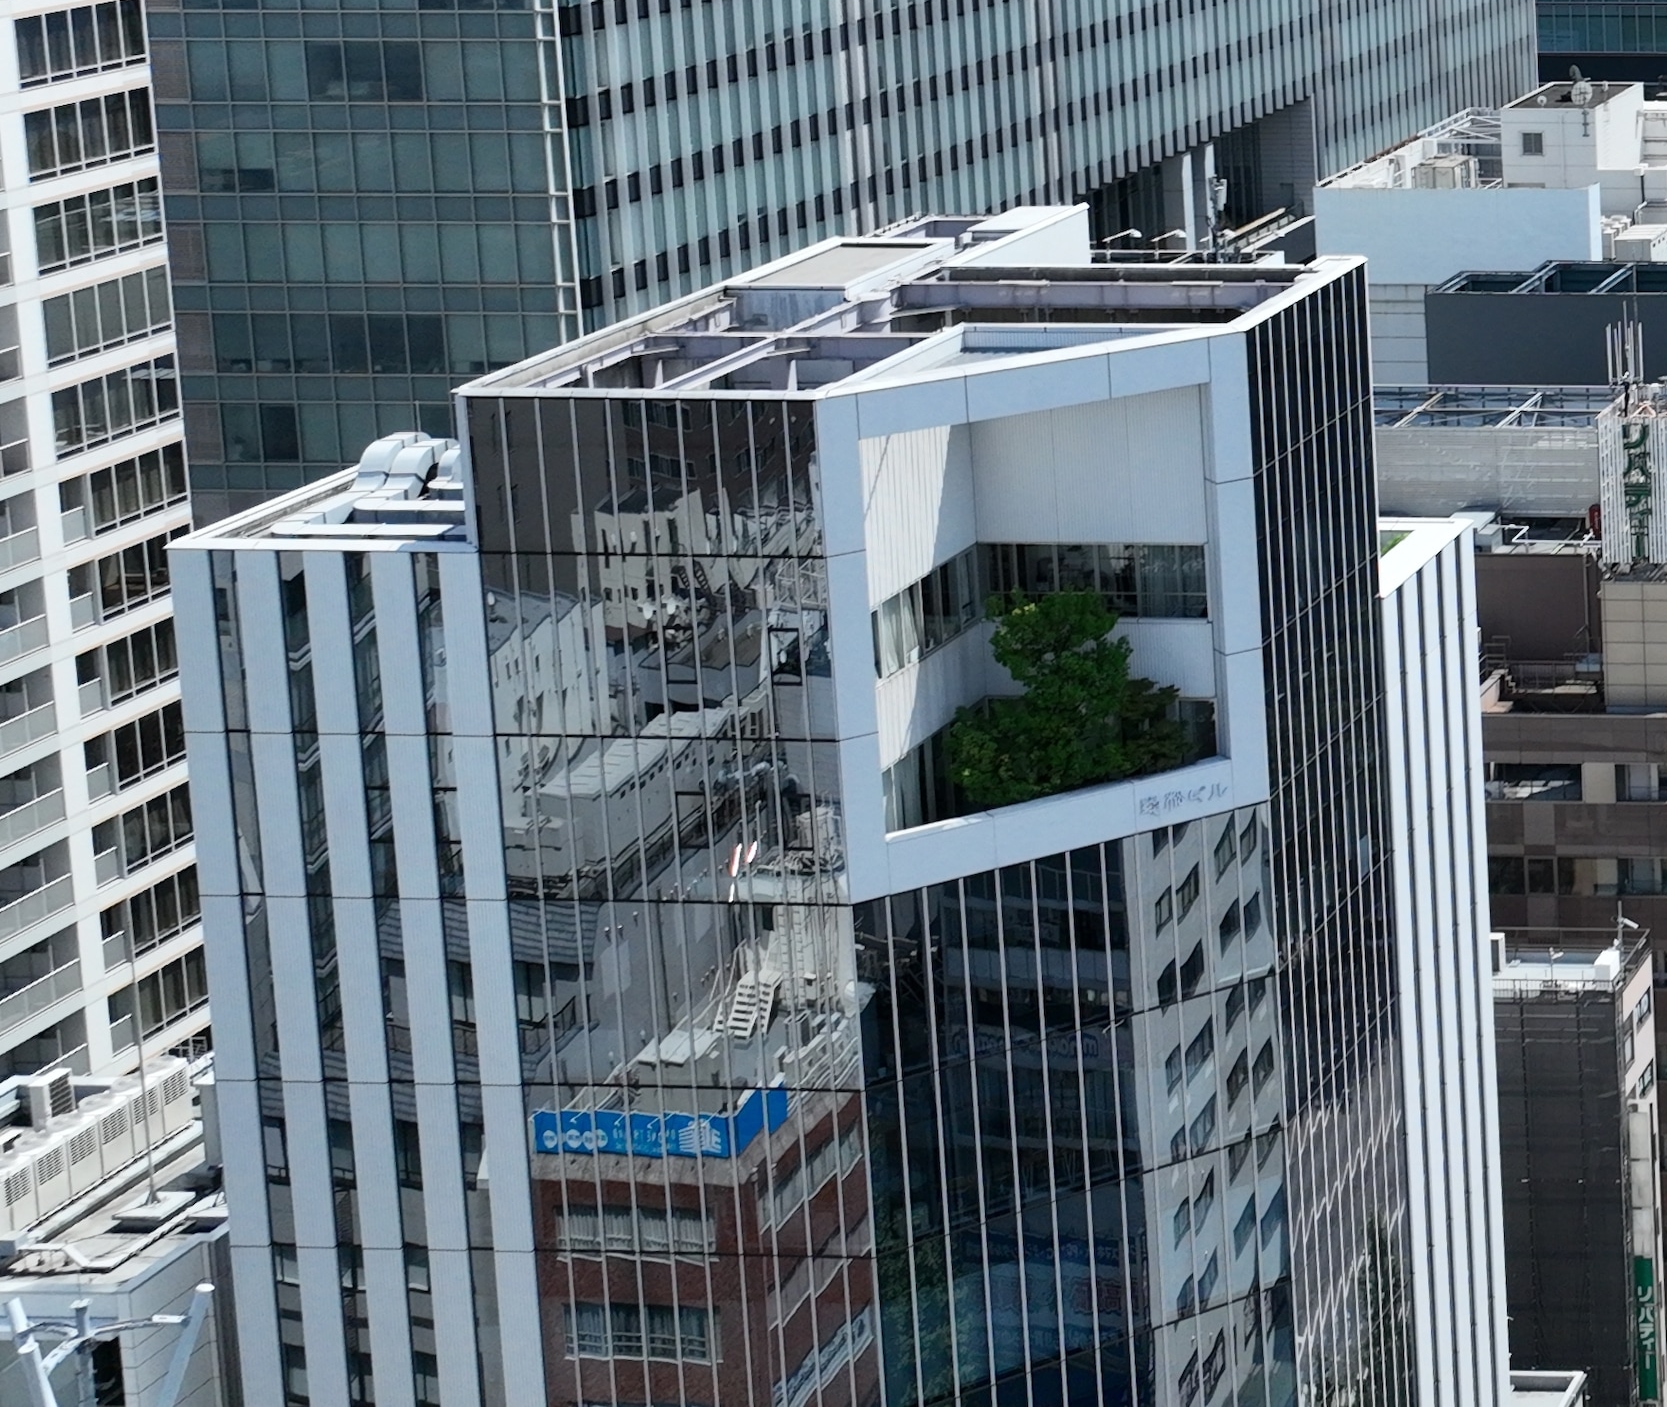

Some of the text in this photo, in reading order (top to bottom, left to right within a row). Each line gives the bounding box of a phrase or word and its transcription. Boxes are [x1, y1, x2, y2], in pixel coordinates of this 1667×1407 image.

[1637, 1286, 1656, 1370] リバティー
